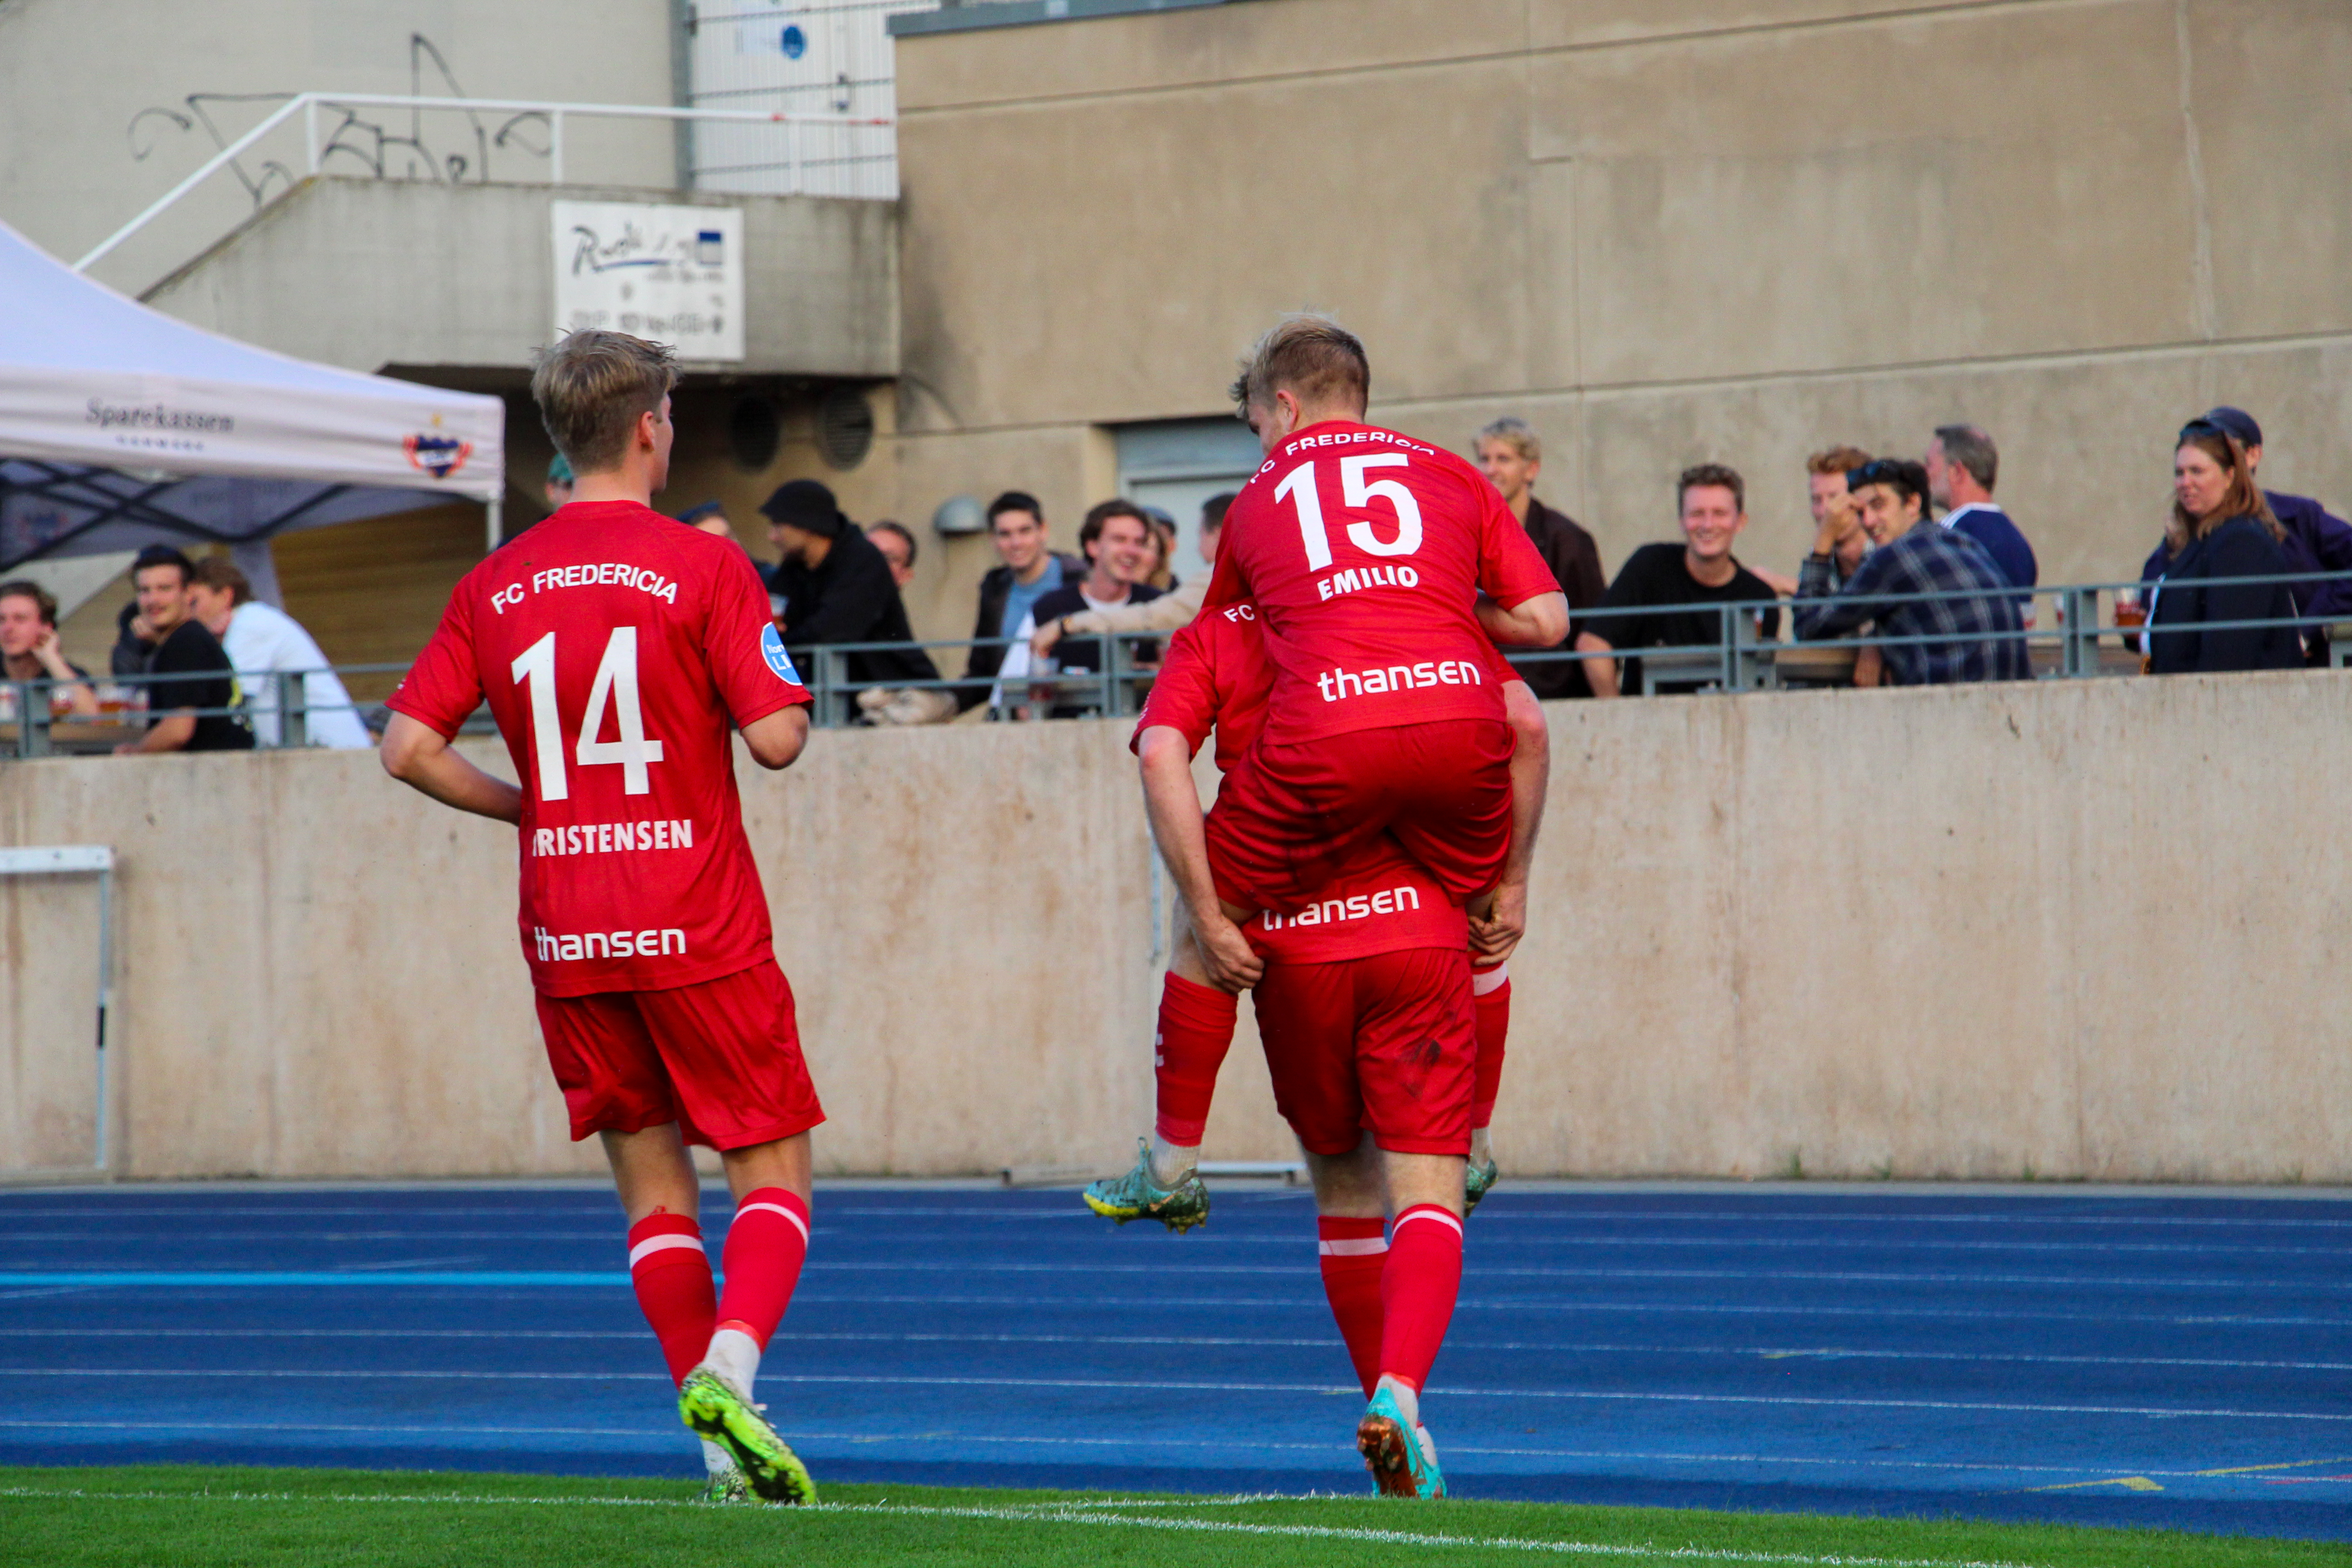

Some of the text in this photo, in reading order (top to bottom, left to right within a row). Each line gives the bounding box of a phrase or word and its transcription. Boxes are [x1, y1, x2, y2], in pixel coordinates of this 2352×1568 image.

[86, 398, 234, 431] Sparekassen
[1274, 452, 1423, 572] 15
[491, 563, 678, 614] FC FREDERICIA
[1317, 565, 1419, 602] EMILIO
[1223, 604, 1255, 622] FC
[1317, 661, 1481, 702] thansen
[511, 626, 664, 801] 14
[533, 819, 693, 857] RISTENSEN
[534, 926, 686, 961] thansen
